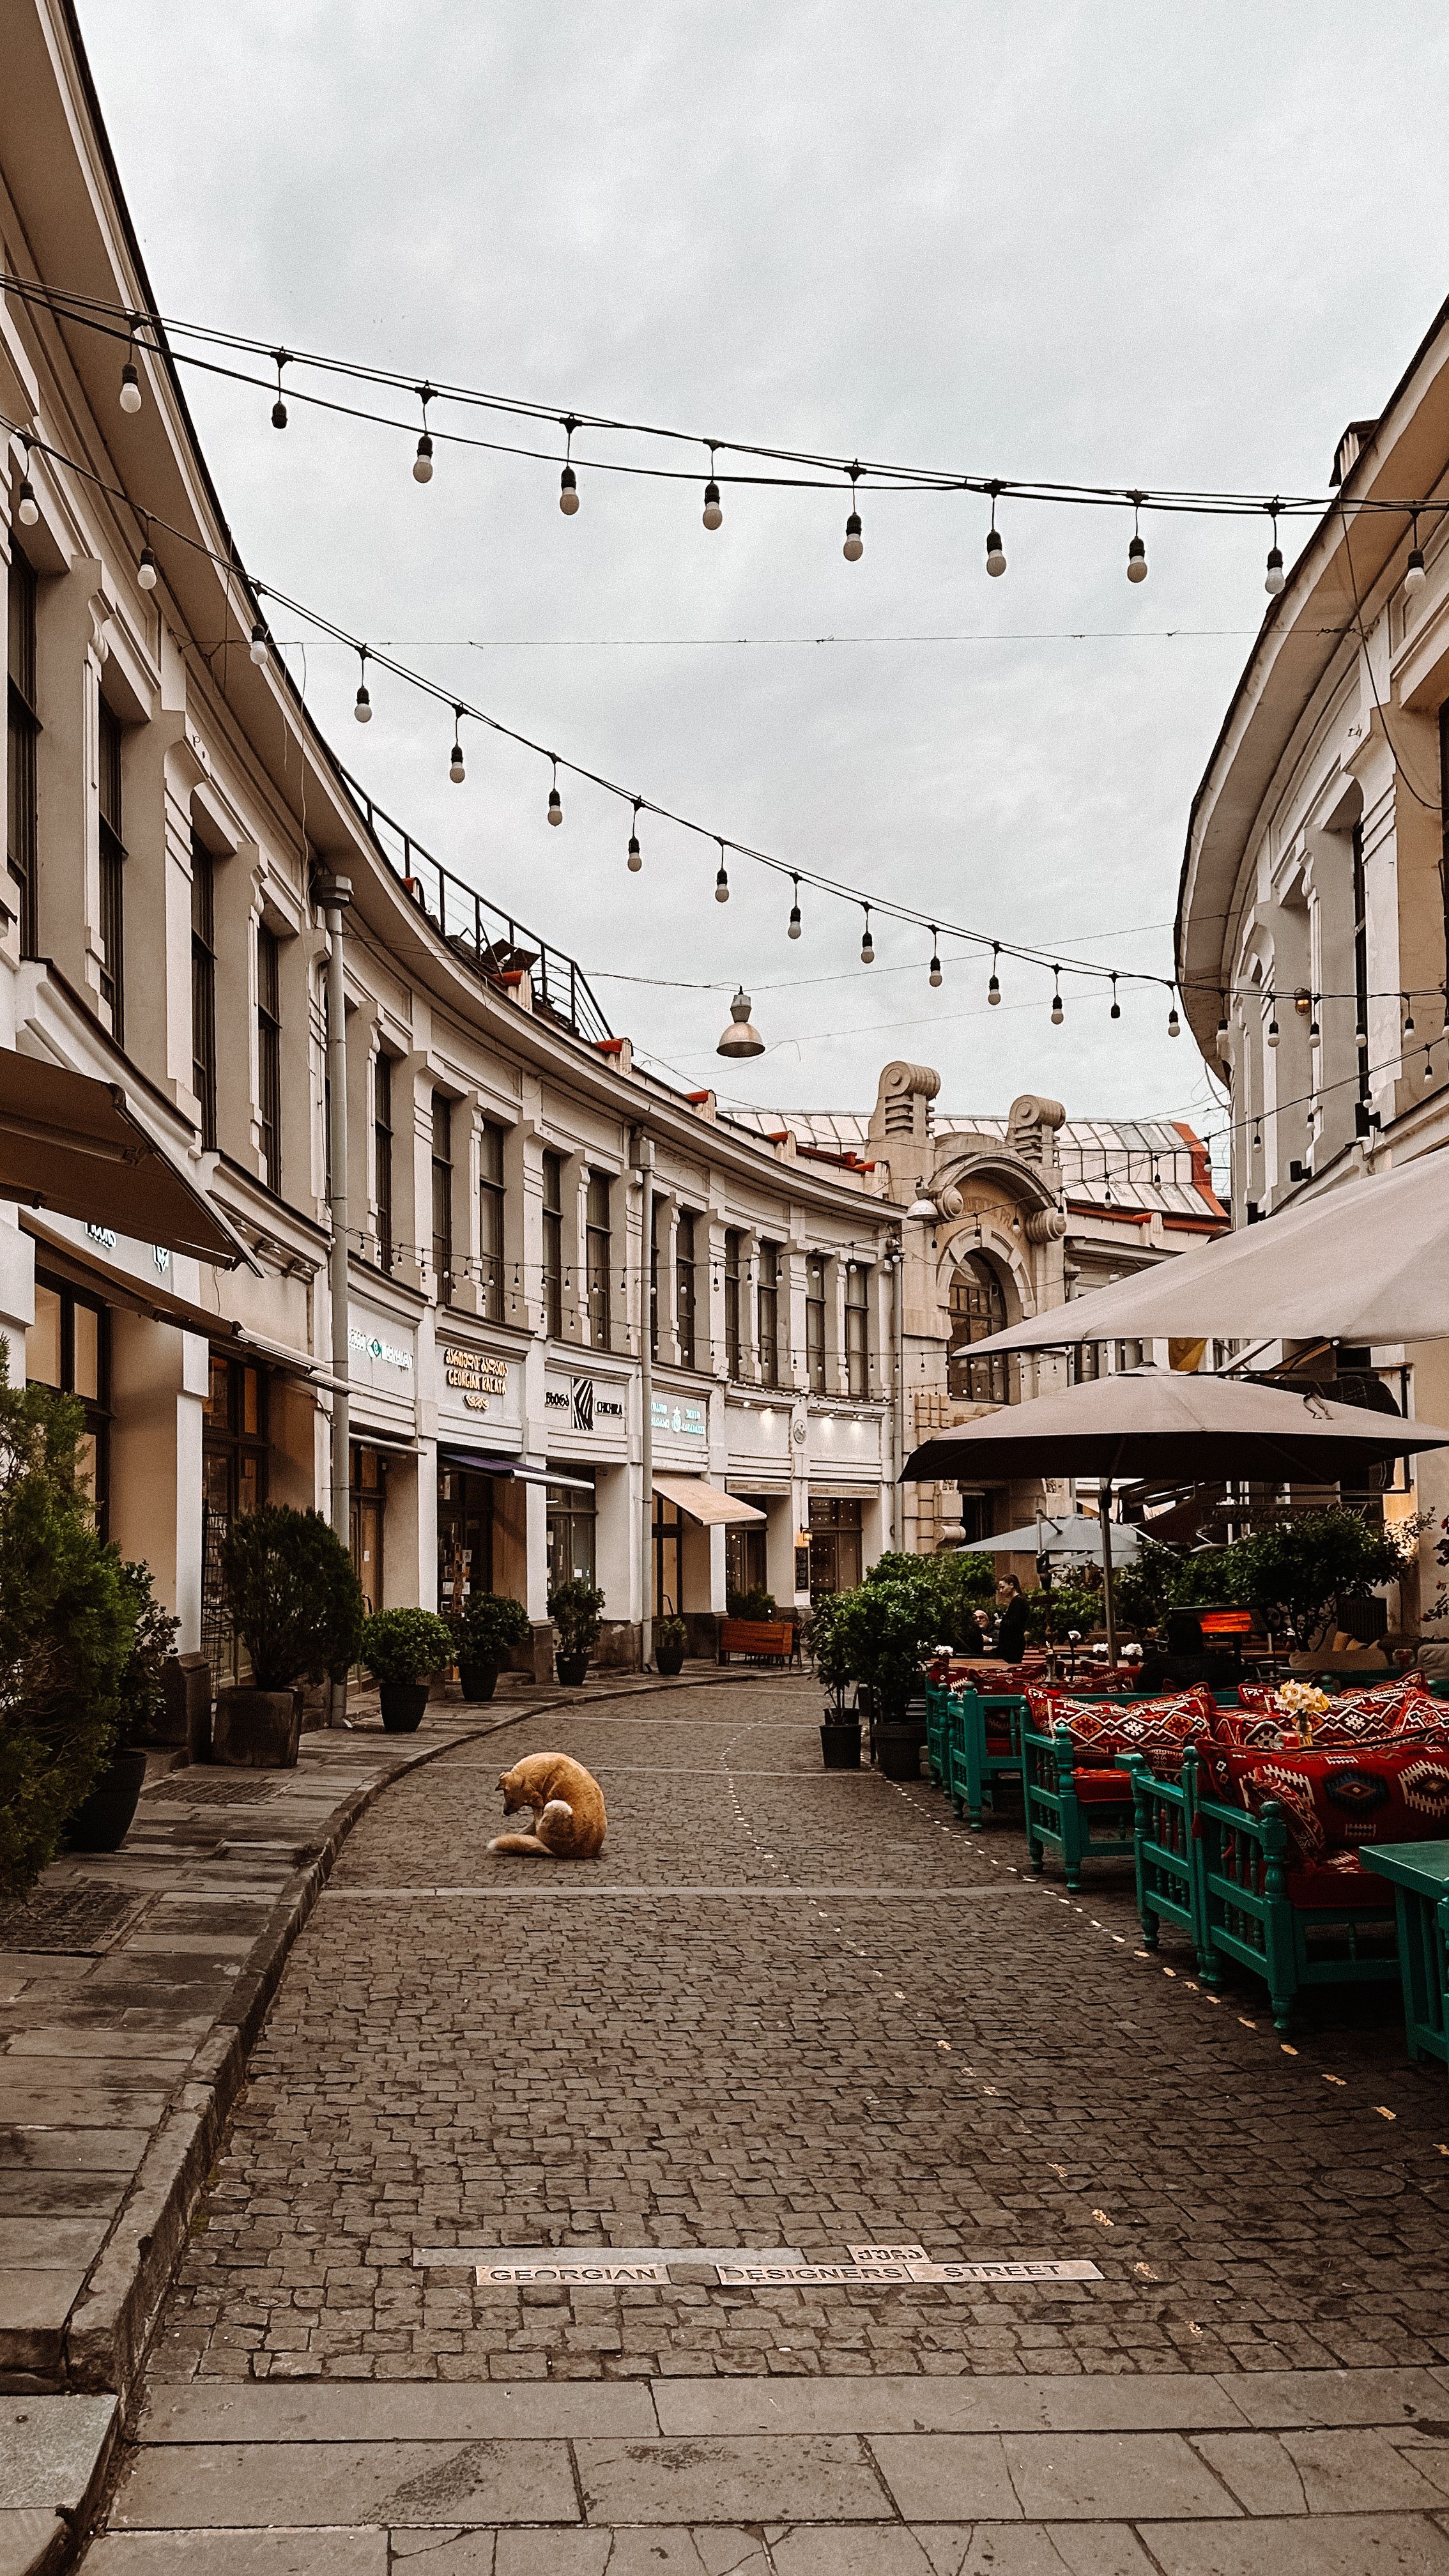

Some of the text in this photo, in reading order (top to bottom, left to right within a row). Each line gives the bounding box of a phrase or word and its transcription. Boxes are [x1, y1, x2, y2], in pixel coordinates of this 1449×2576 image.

[448, 1369, 507, 1395] GEORGIAN KALATA
[857, 2249, 923, 2262] ქუჩა
[490, 2264, 1061, 2281] GEORGIAN DESIGNERS STREET
